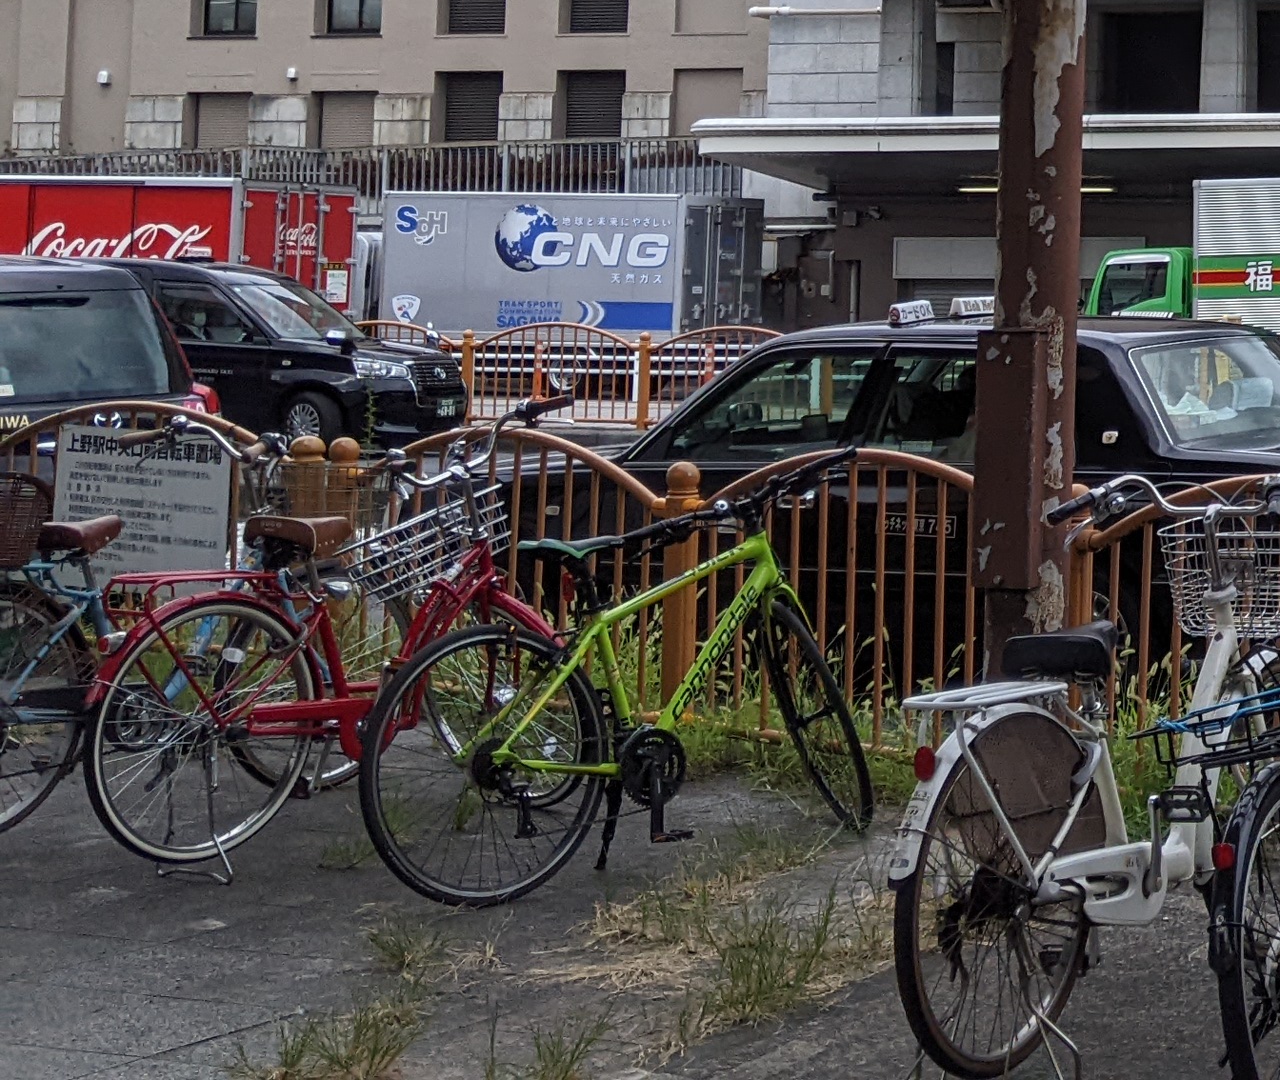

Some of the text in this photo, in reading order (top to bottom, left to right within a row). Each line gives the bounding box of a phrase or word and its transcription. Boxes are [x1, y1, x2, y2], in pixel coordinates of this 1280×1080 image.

[531, 232, 670, 268] CNG
[610, 273, 663, 285] 天然ガス
[498, 300, 559, 308] TRANSPORT
[672, 585, 759, 721] cannondale
